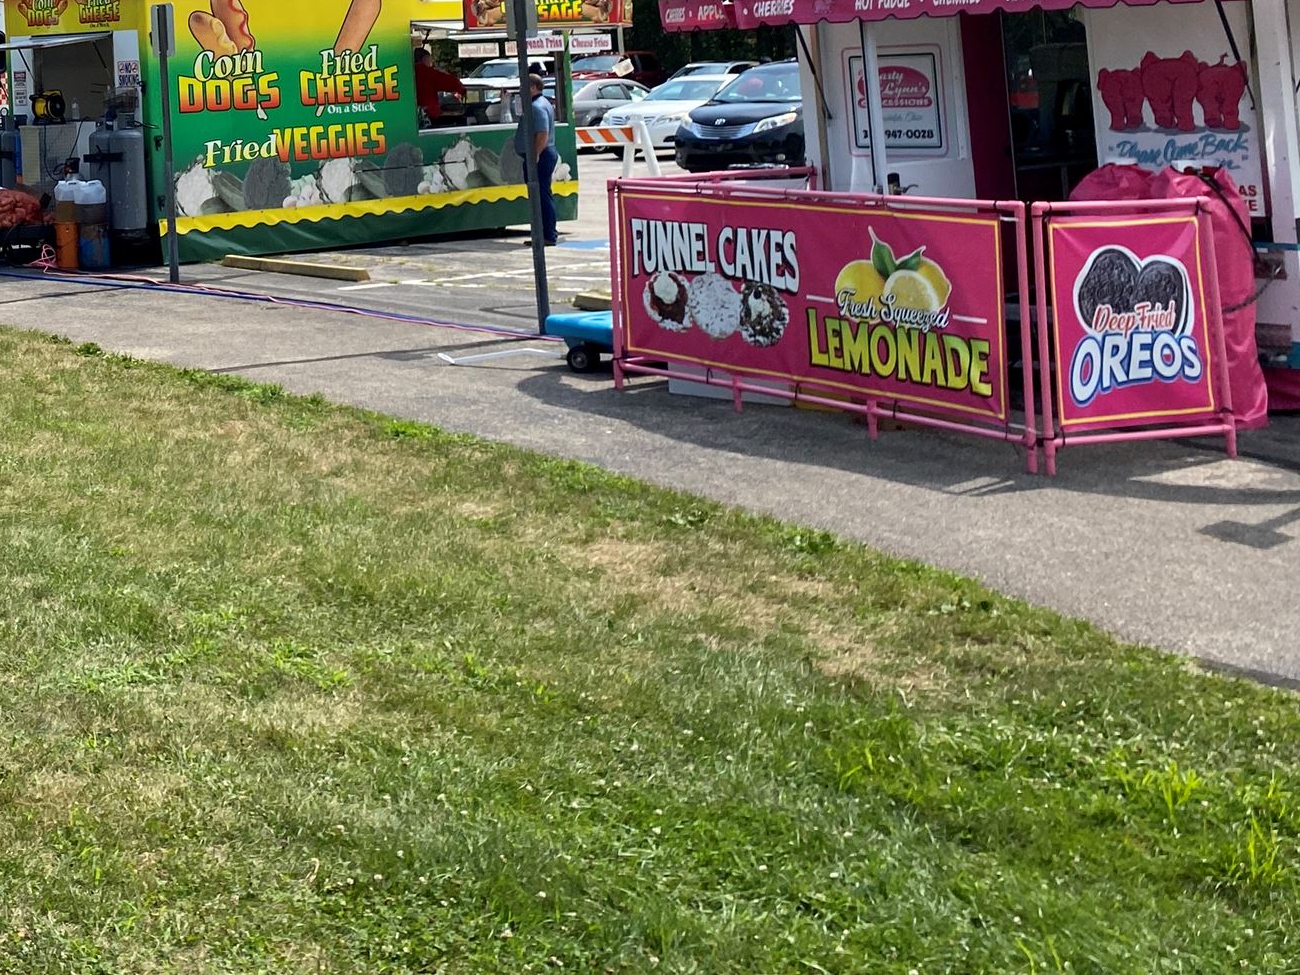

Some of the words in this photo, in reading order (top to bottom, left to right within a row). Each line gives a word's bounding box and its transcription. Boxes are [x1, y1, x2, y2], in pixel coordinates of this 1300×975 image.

[27, 7, 59, 27] DOGS
[80, 1, 120, 23] CHEESE
[320, 45, 378, 79] Fried
[526, 37, 544, 50] rench
[571, 38, 593, 48] Cheese
[594, 37, 609, 48] Fries
[194, 48, 264, 82] Corn
[178, 72, 280, 113] DOGS
[300, 65, 399, 106] CHEESE
[327, 105, 342, 114] On
[352, 101, 377, 113] Stick
[203, 134, 278, 169] Fried
[273, 121, 387, 162] VEGGIES
[631, 218, 715, 276] FUNNEL
[718, 226, 800, 293] CAKES
[836, 288, 878, 318] Fresh
[879, 294, 950, 333] Squeezed
[1093, 304, 1136, 339] Deep
[1135, 299, 1176, 330] Fried
[806, 307, 993, 397] LEMONADE
[1072, 331, 1202, 404] OREOS
